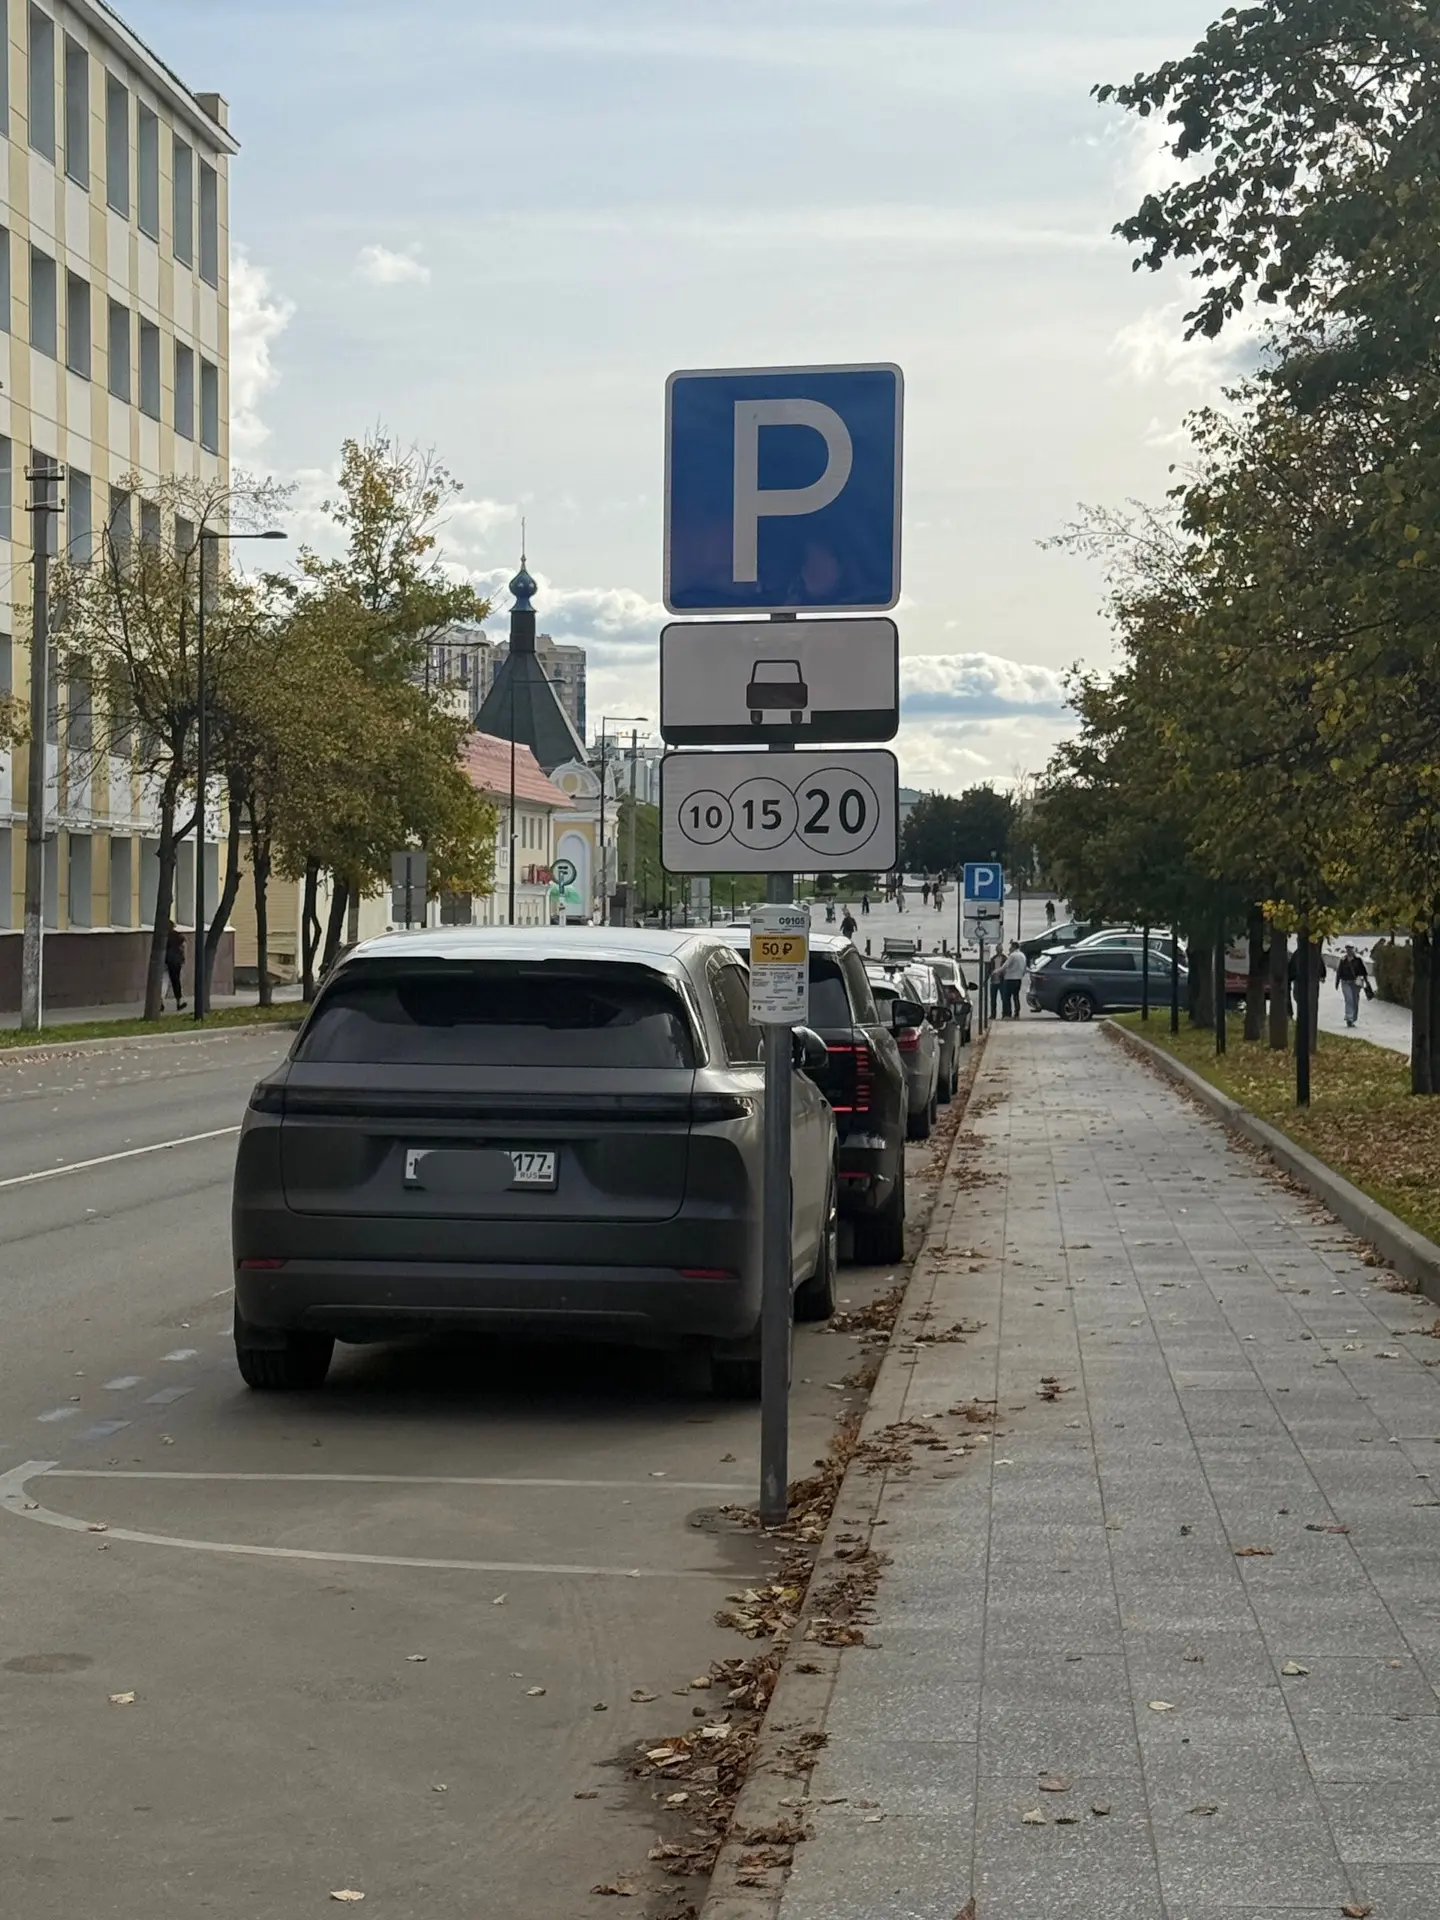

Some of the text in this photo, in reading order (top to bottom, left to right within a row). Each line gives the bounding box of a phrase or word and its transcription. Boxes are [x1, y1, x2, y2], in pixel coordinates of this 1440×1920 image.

[732, 398, 853, 582] P
[689, 788, 867, 834] 10 15 20
[974, 867, 994, 896] P
[762, 942, 779, 956] 50
[513, 1153, 548, 1172] 177
[519, 1171, 538, 1180] RUS
